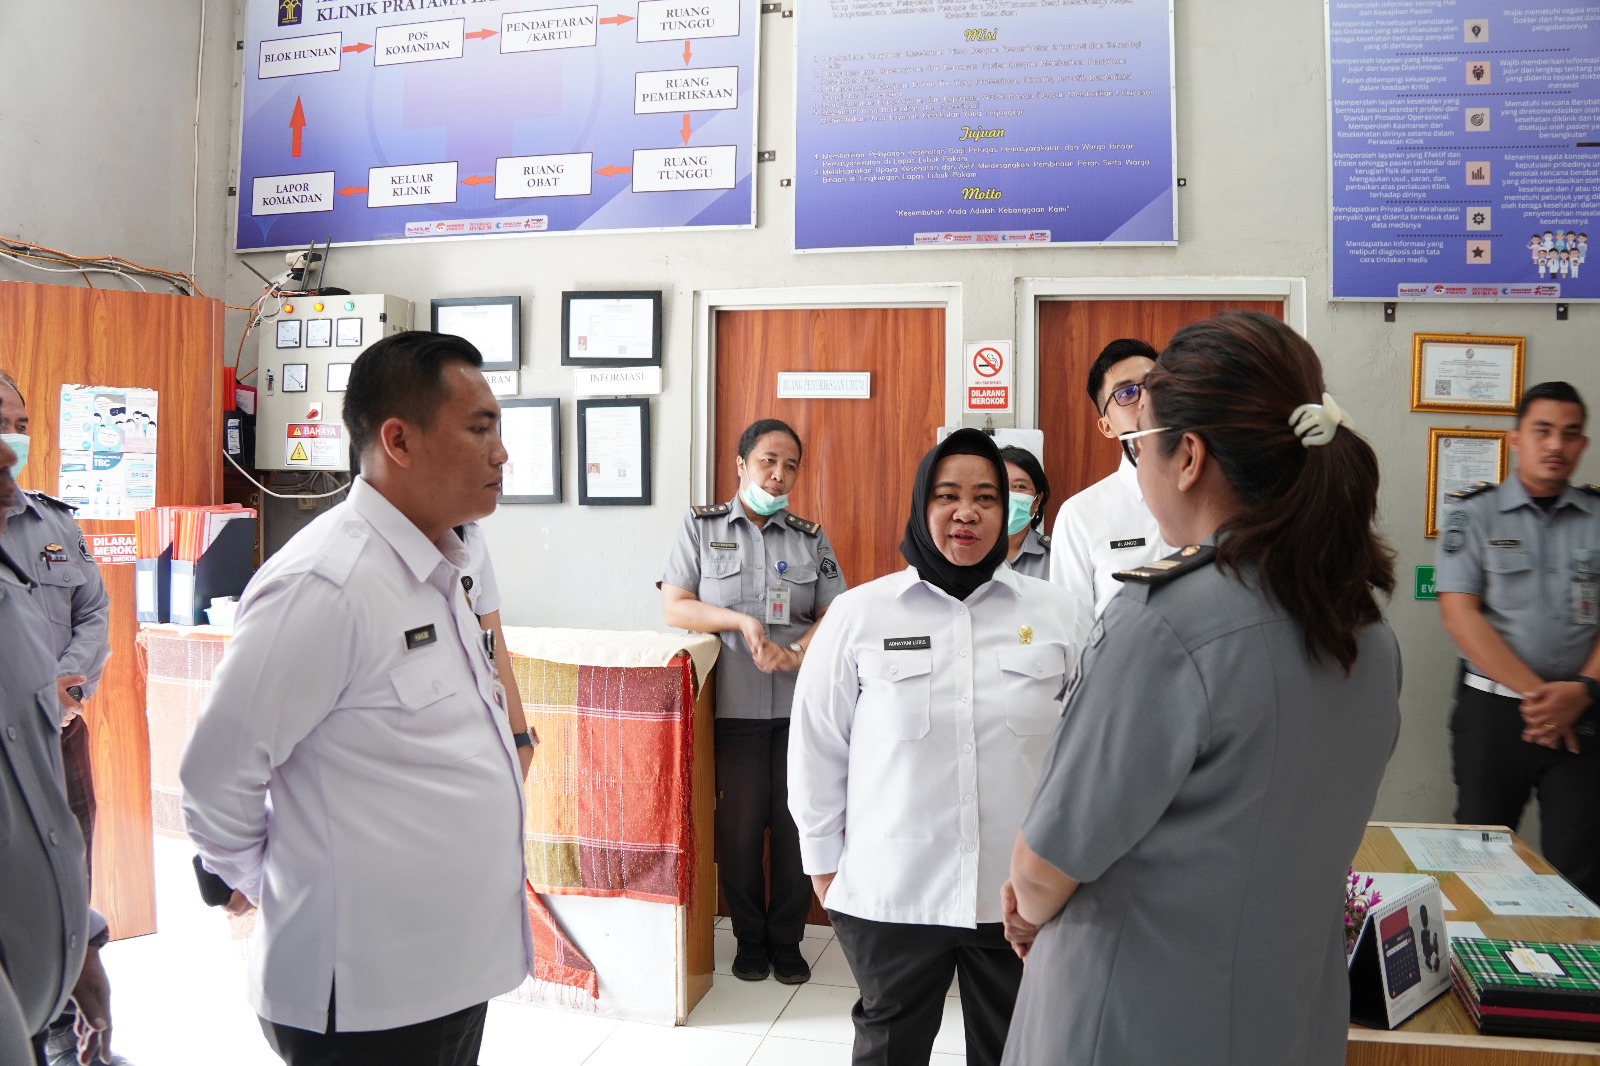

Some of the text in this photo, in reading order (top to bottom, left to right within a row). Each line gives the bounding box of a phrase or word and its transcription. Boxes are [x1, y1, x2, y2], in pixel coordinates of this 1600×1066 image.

[317, 2, 378, 21] KLINIK
[666, 6, 710, 19] RUANG
[507, 16, 594, 32] PENDAFTARAN
[660, 19, 715, 31] TUNGGU
[1532, 24, 1588, 32] pengobatannya
[408, 31, 428, 41] POS
[527, 31, 572, 44] /KARTU
[964, 28, 998, 42] Misi
[386, 41, 450, 56] KOMANDAN
[264, 47, 337, 63] BLOK HUNIAN
[666, 77, 709, 89] RUANG
[642, 88, 733, 102] PEMERIKSAAN
[664, 156, 707, 167] RUANG
[523, 165, 564, 175] RUANG
[657, 168, 712, 180] TUNGGU
[1355, 168, 1384, 176] kerugian
[391, 174, 433, 184] KELUAR
[527, 178, 560, 187] OBAT
[276, 183, 310, 193] LAPOR
[392, 186, 431, 197] KLINIK
[262, 193, 322, 206] KOMANDAN
[962, 188, 1002, 200] Motto
[999, 206, 1044, 214] Kebanggaan
[590, 372, 644, 382] INFORMASI
[783, 380, 802, 390] RUANG
[804, 380, 844, 390] PEMERIKSAAN
[304, 427, 336, 435] BAHAYA
[94, 459, 110, 467] TBC
